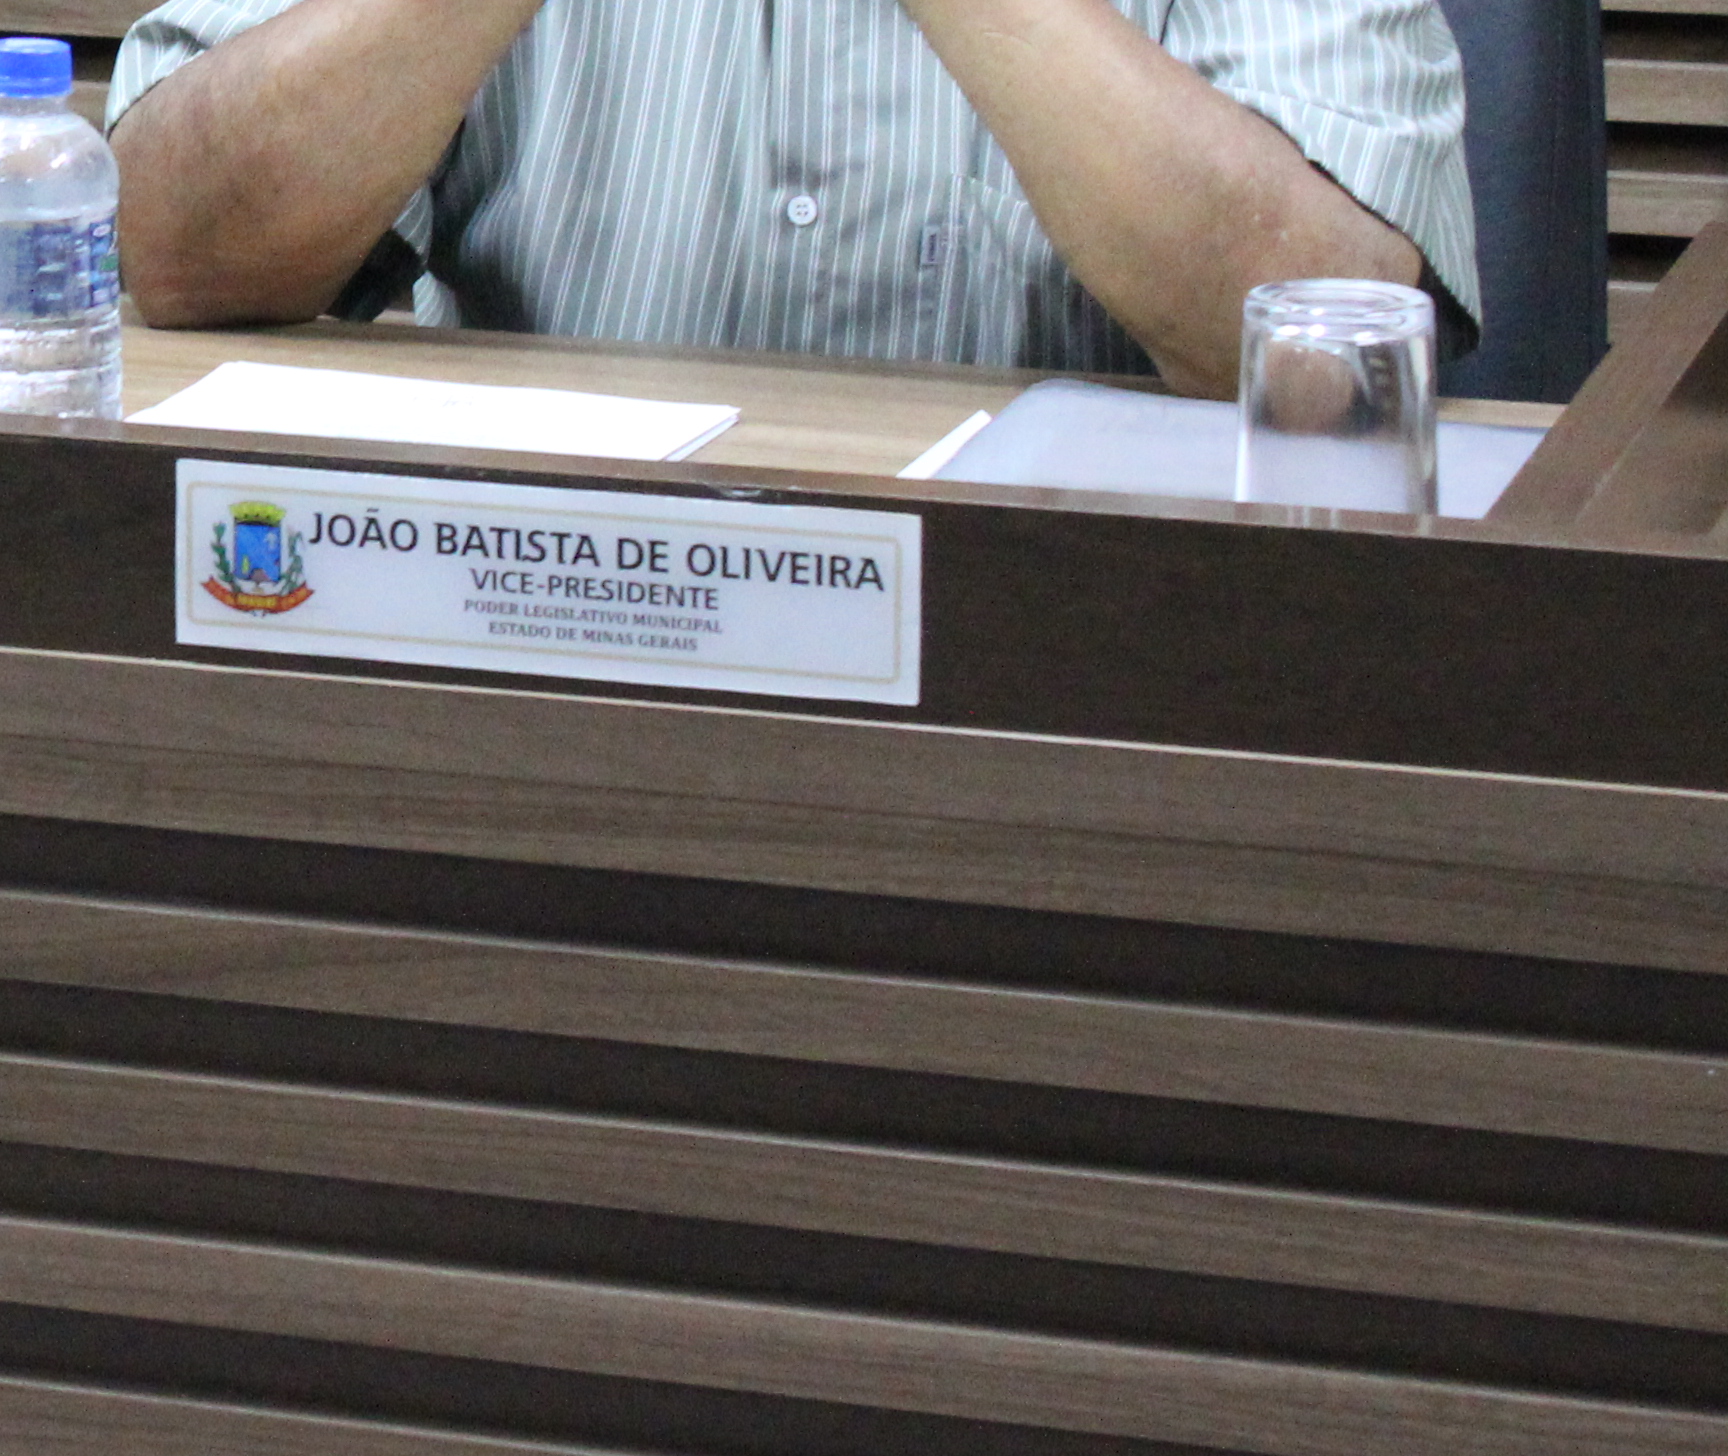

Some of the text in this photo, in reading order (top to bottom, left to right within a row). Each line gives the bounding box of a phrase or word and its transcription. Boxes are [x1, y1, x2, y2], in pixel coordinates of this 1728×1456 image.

[308, 508, 885, 592] JOÃO BATISTA DE OLIVEIRA
[469, 568, 719, 610] VICE-PRESIDENTE
[464, 599, 723, 634] PODER LEGISLATIVO MUNICIPAL
[488, 621, 698, 651] ESTADO DE MINAS GERAIS
